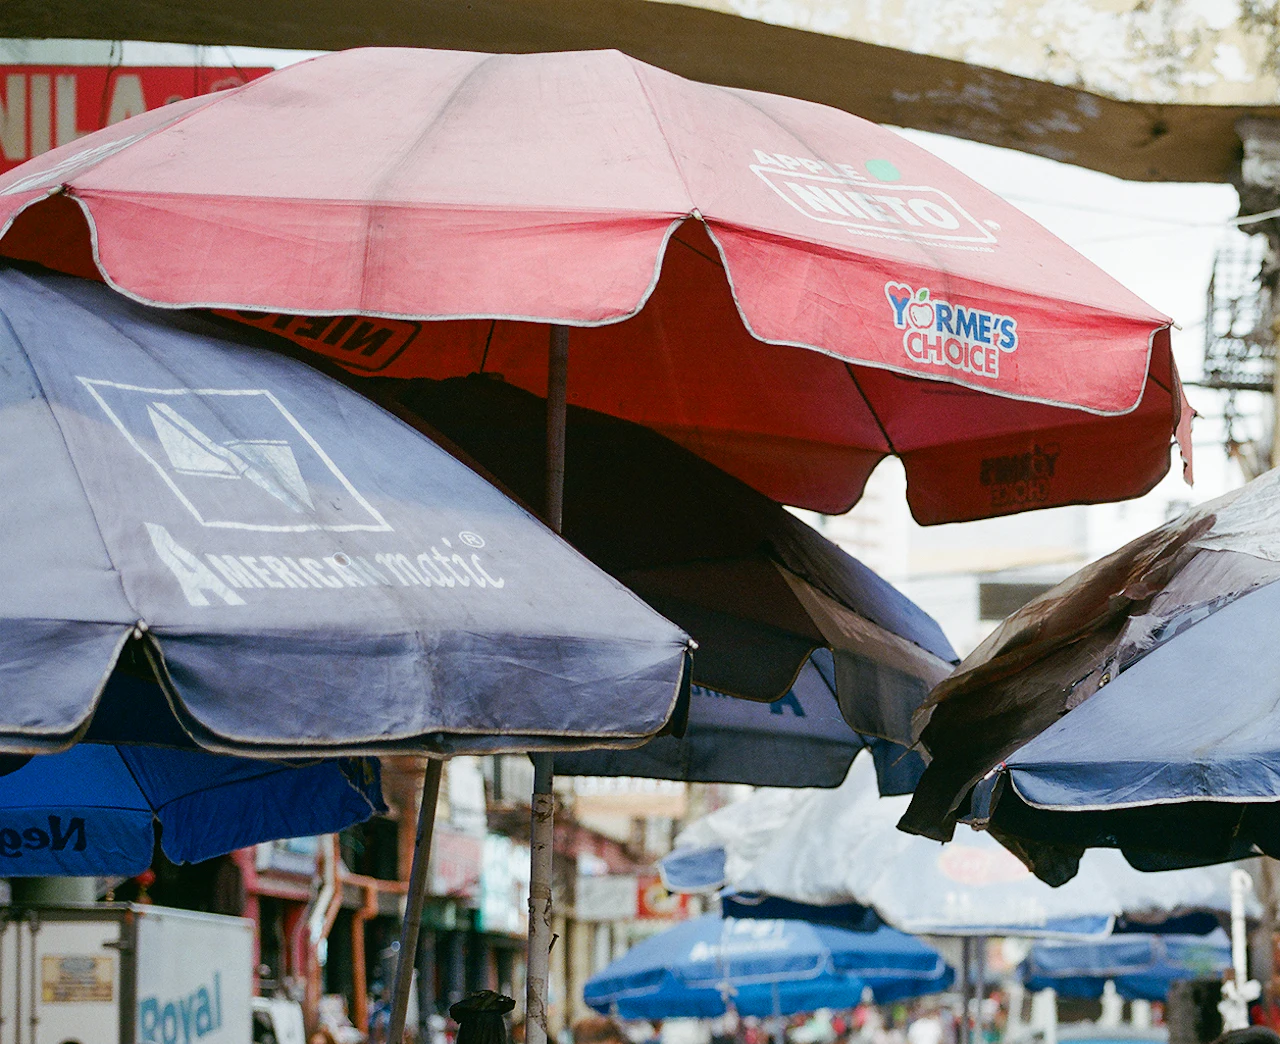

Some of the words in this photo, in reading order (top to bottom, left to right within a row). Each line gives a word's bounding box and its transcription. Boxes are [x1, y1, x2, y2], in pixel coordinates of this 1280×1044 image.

[782, 180, 962, 231] NIETO
[904, 331, 999, 375] CHOICE
[144, 522, 388, 606] AMERICAN
[375, 535, 505, 589] matic
